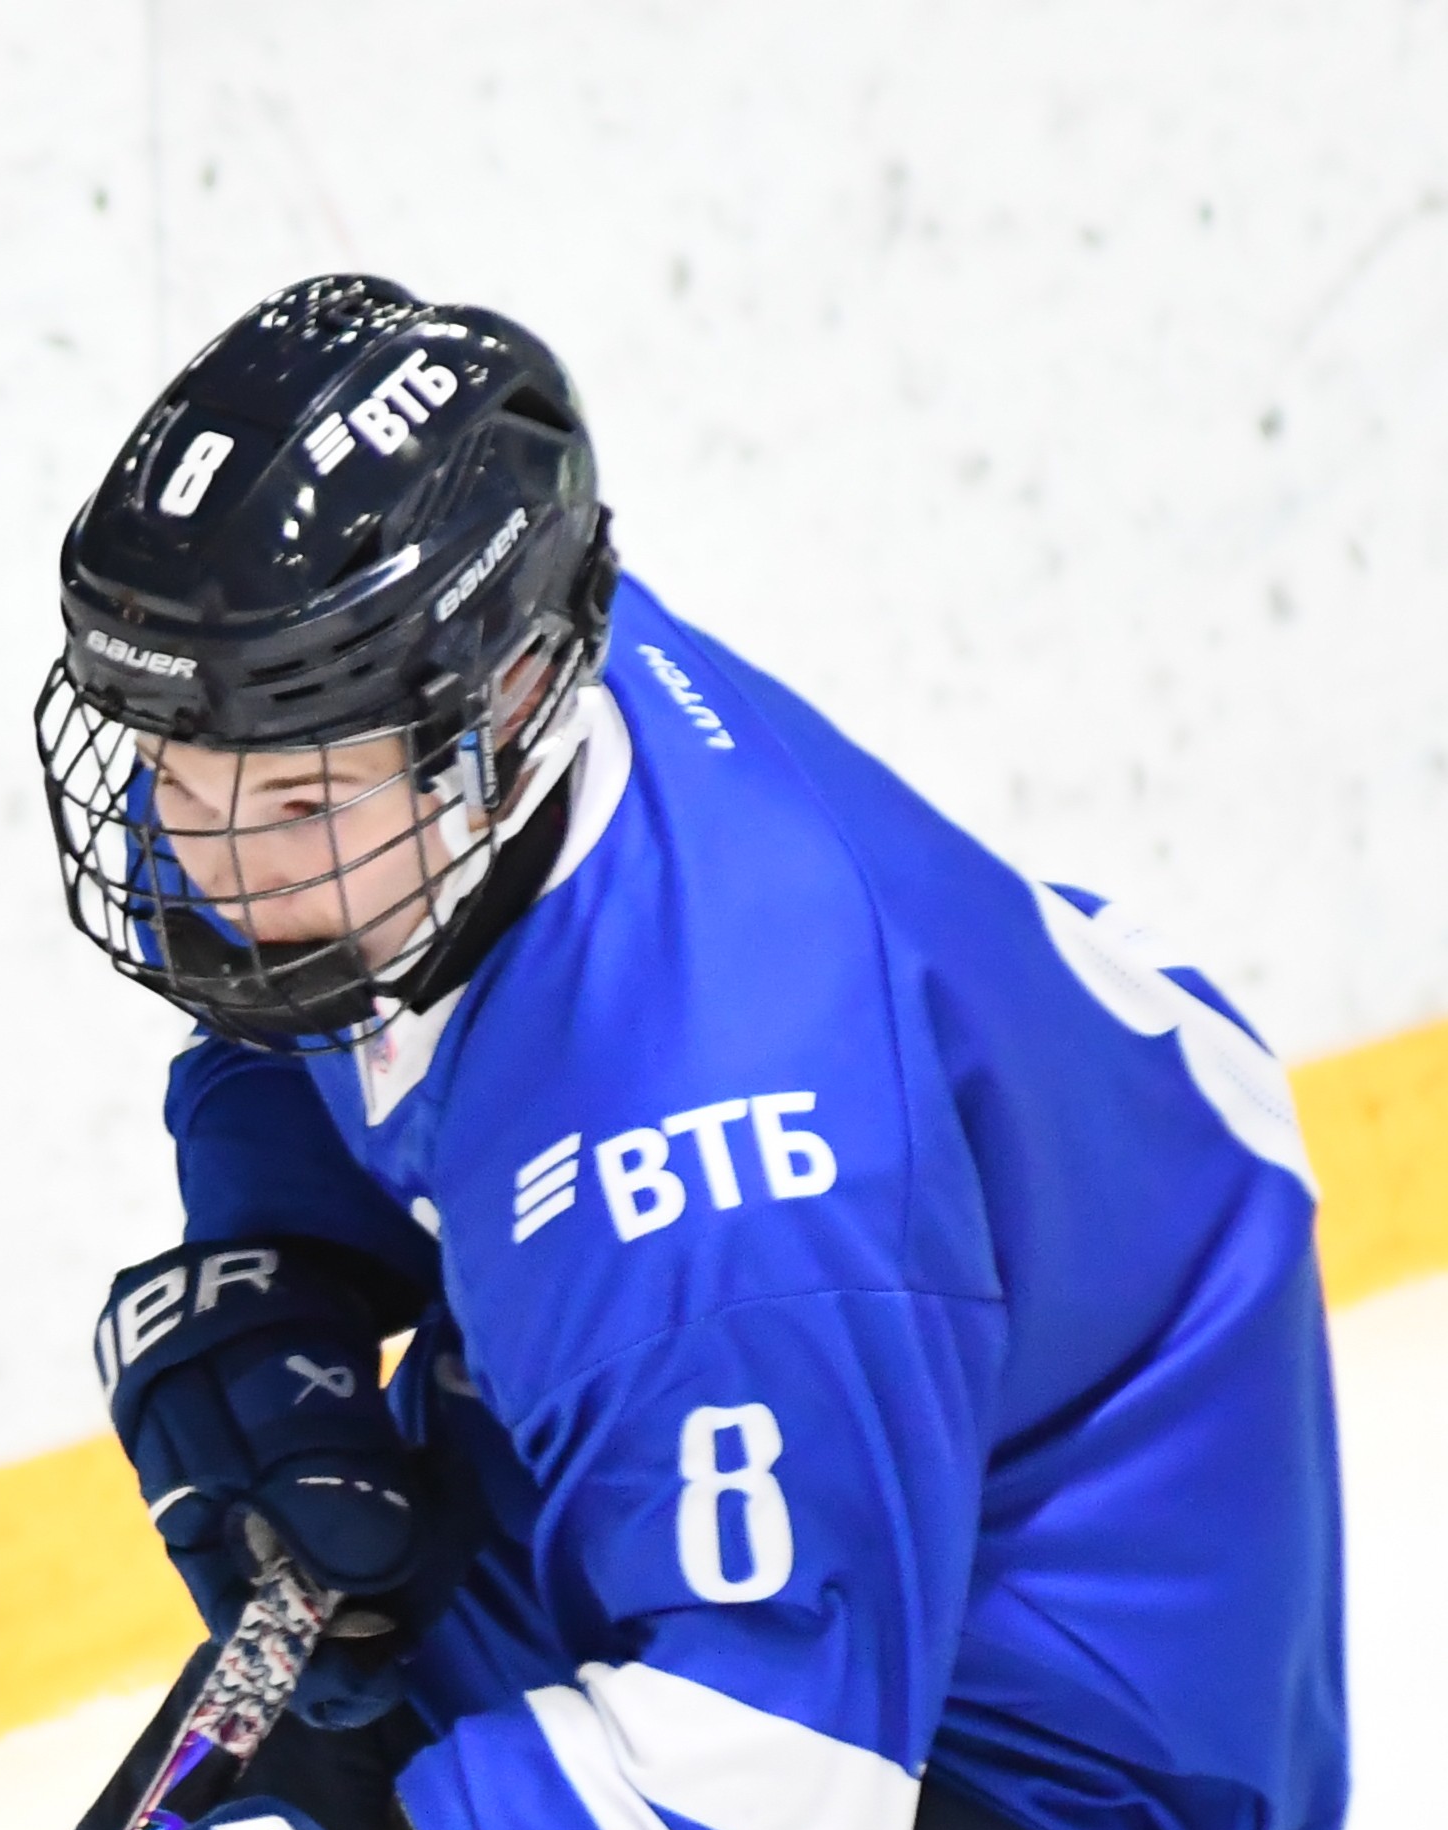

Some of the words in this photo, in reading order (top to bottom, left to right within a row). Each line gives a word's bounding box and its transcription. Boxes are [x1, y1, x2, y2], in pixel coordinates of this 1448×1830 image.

[347, 348, 458, 456] ВТБ
[159, 430, 234, 517] 8
[434, 506, 529, 623] BAUER
[86, 629, 199, 680] BAUER
[594, 1090, 838, 1243] ВТБ
[675, 1402, 795, 1604] 8
